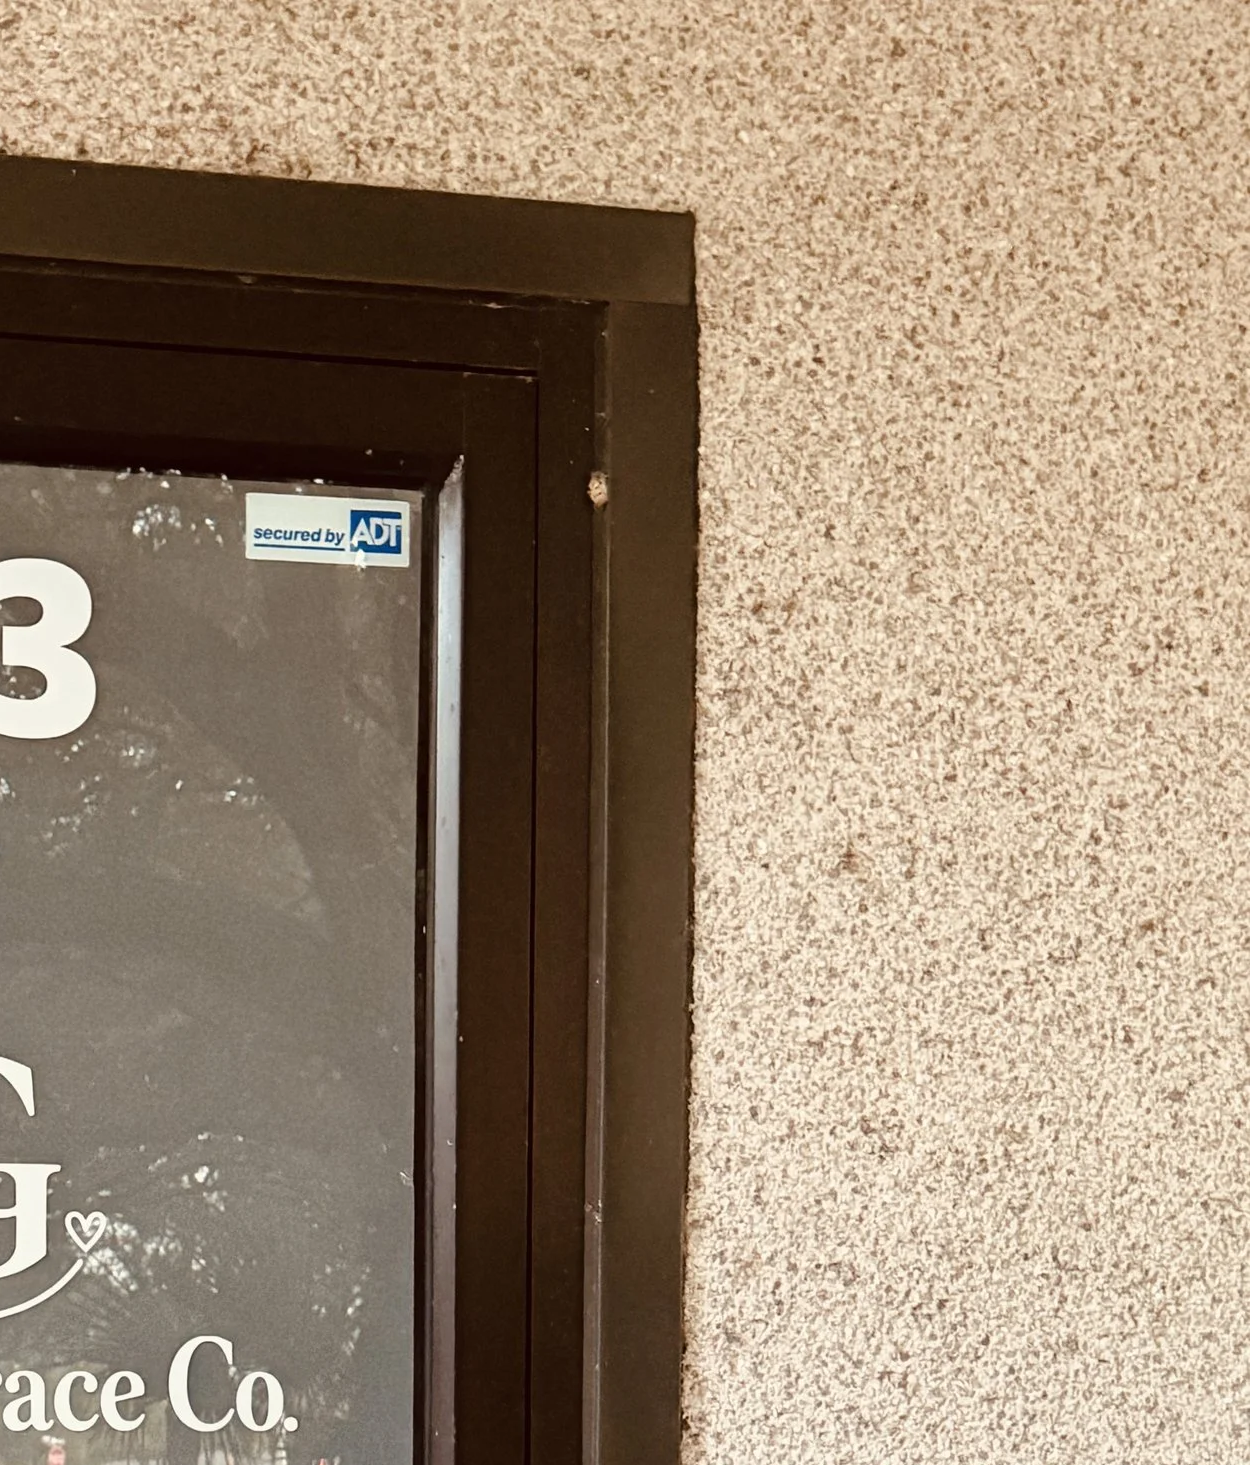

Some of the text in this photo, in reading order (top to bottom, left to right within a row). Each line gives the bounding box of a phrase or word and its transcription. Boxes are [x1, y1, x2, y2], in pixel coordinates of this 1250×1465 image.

[253, 517, 402, 548] secured by ADT
[167, 1335, 300, 1433] Co.
